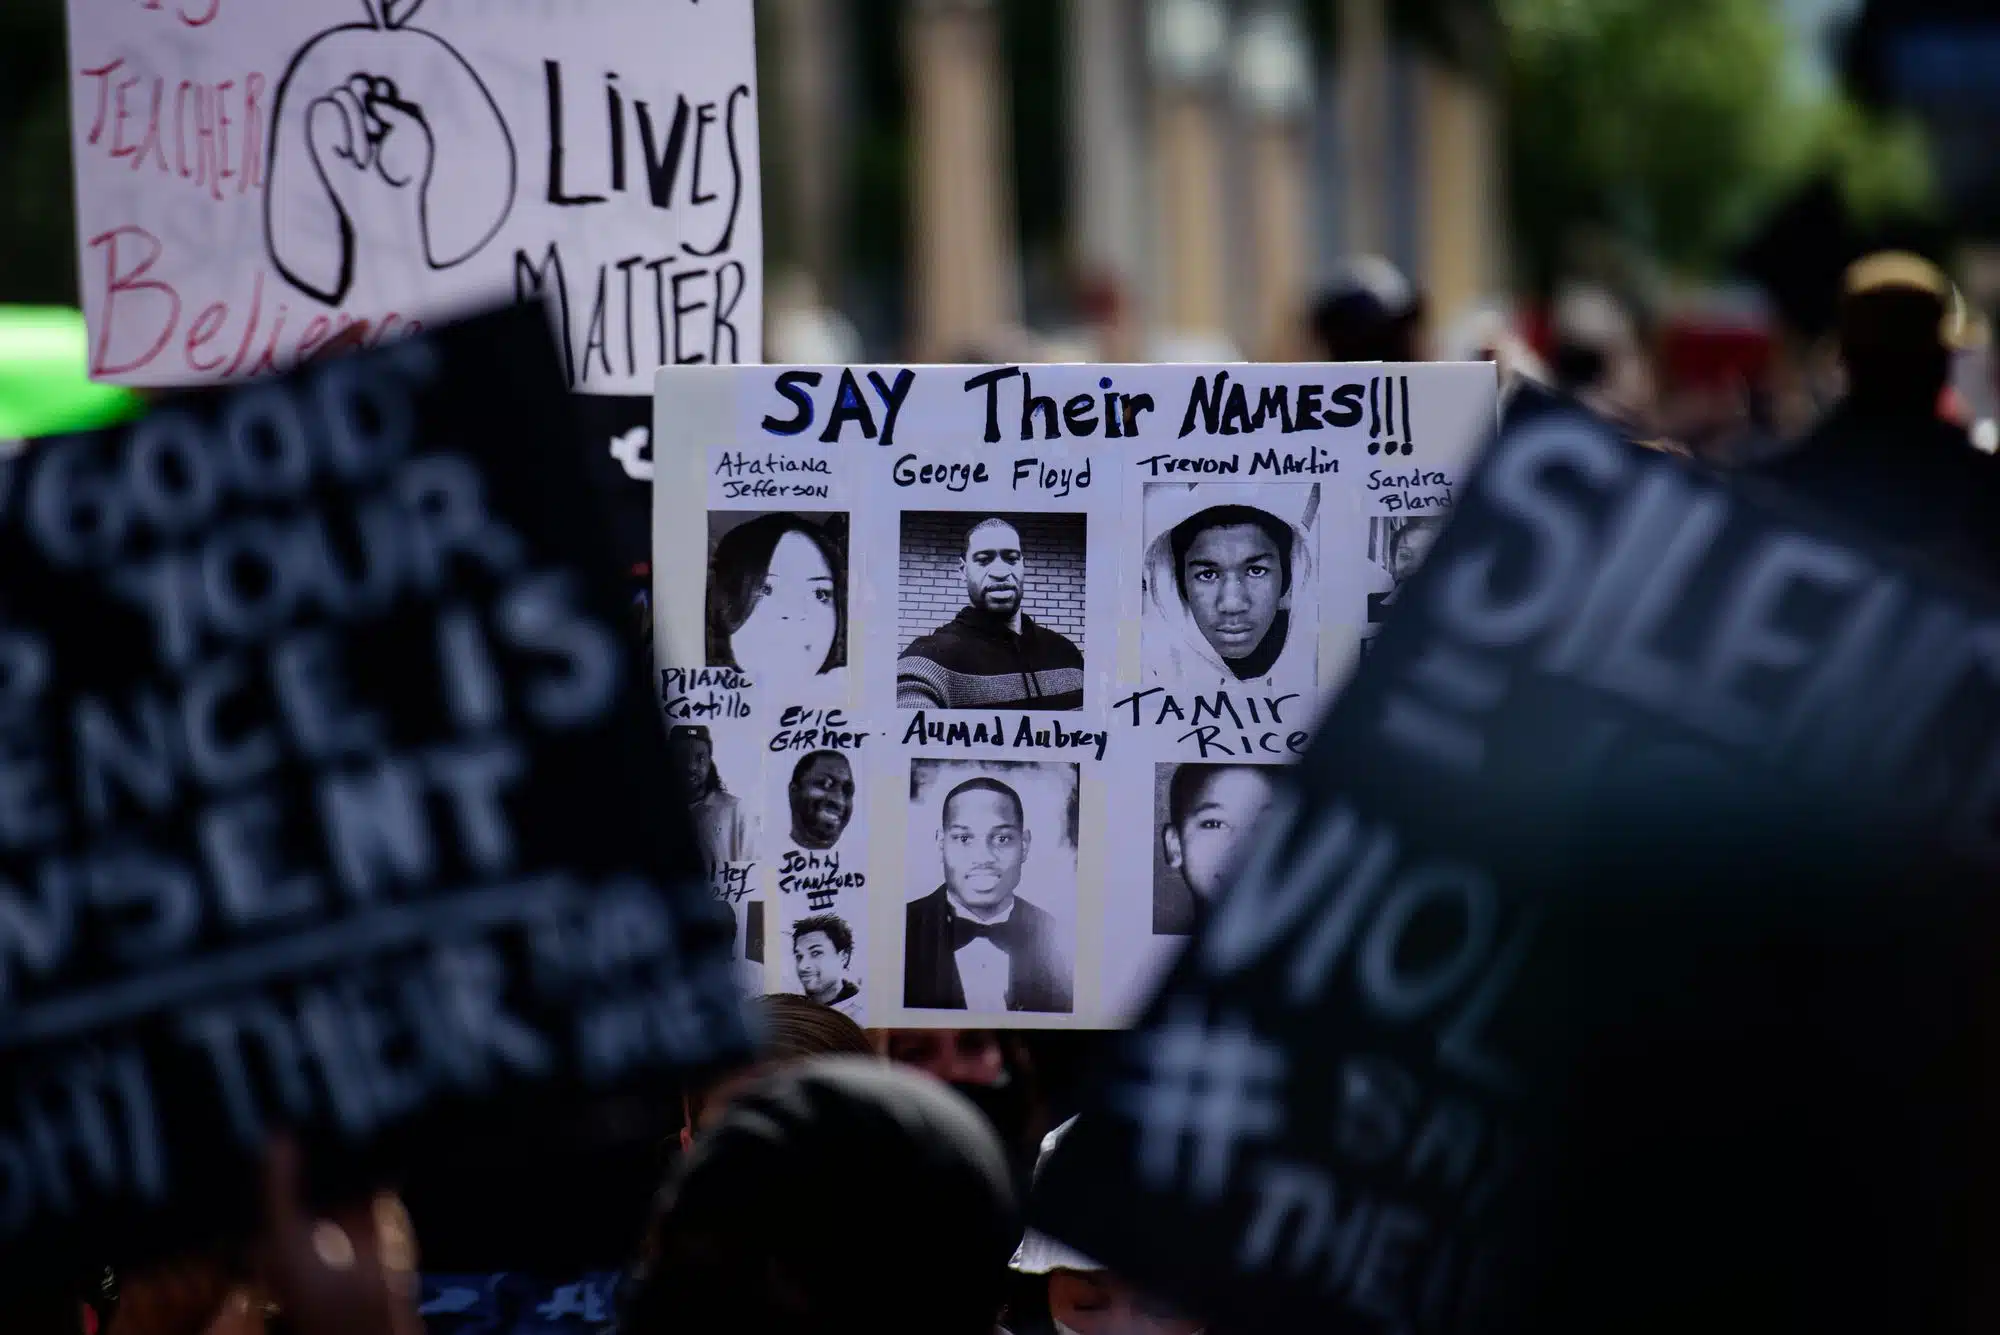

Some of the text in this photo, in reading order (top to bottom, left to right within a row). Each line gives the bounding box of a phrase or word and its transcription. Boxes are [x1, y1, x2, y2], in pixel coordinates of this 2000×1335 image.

[514, 241, 746, 389] MATTER
[761, 367, 917, 446] SAY
[964, 366, 1155, 443] Their
[893, 453, 1092, 498] George Floyd
[1366, 467, 1453, 491] Sandra
[1379, 488, 1453, 513] Bland
[664, 690, 751, 720] Castillo
